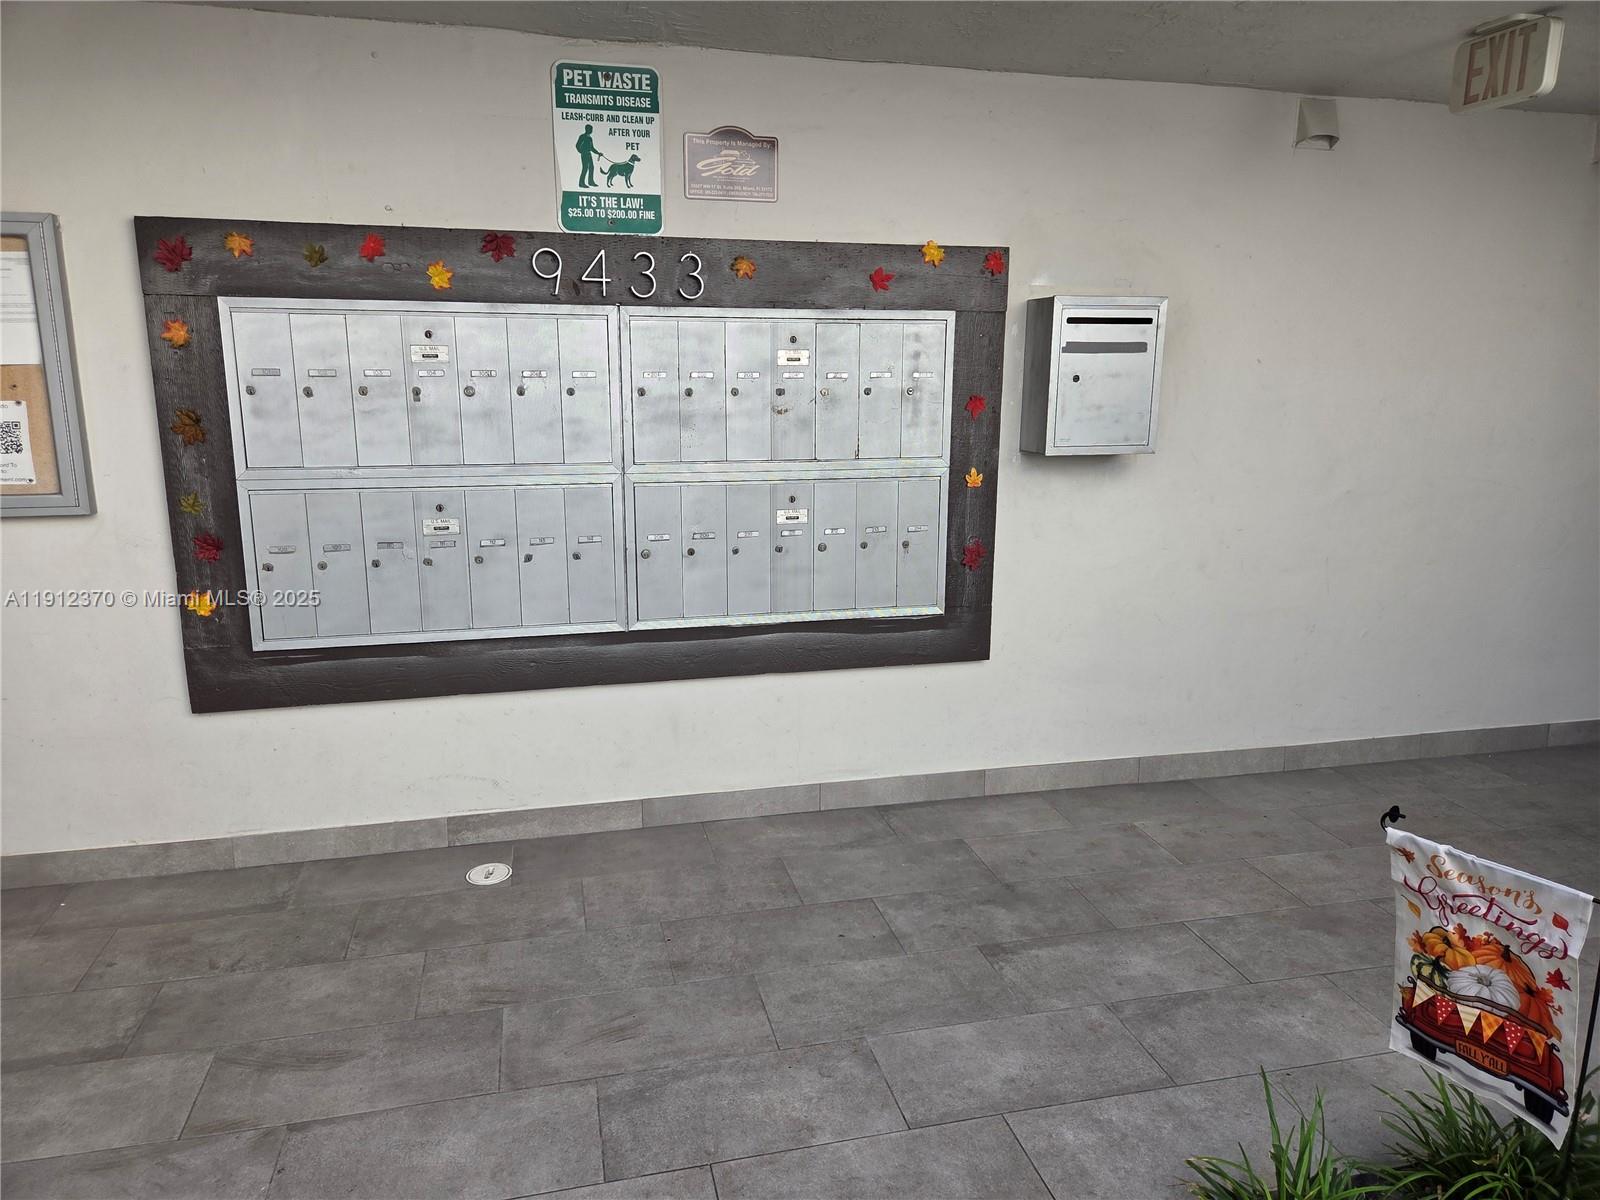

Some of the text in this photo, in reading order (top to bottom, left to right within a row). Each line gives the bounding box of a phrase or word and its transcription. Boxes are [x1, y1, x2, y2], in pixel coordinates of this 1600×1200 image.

[1463, 22, 1538, 106] EXIT
[562, 68, 651, 90] PET WASTE
[564, 93, 651, 108] TRANSMITS DISEASE
[561, 111, 655, 125] LEASH-CURB AND CLEAN UP
[608, 128, 651, 138] AFTER YOUR
[626, 142, 640, 151] PET
[706, 139, 730, 147] Property
[578, 195, 644, 209] IT'S THE LAW!
[568, 208, 656, 220] $25.00 TO $200.00 FINE
[532, 247, 705, 299] 9433
[1426, 854, 1543, 915] Season's
[1403, 875, 1568, 960] Greetings
[1458, 1042, 1480, 1061] FALL
